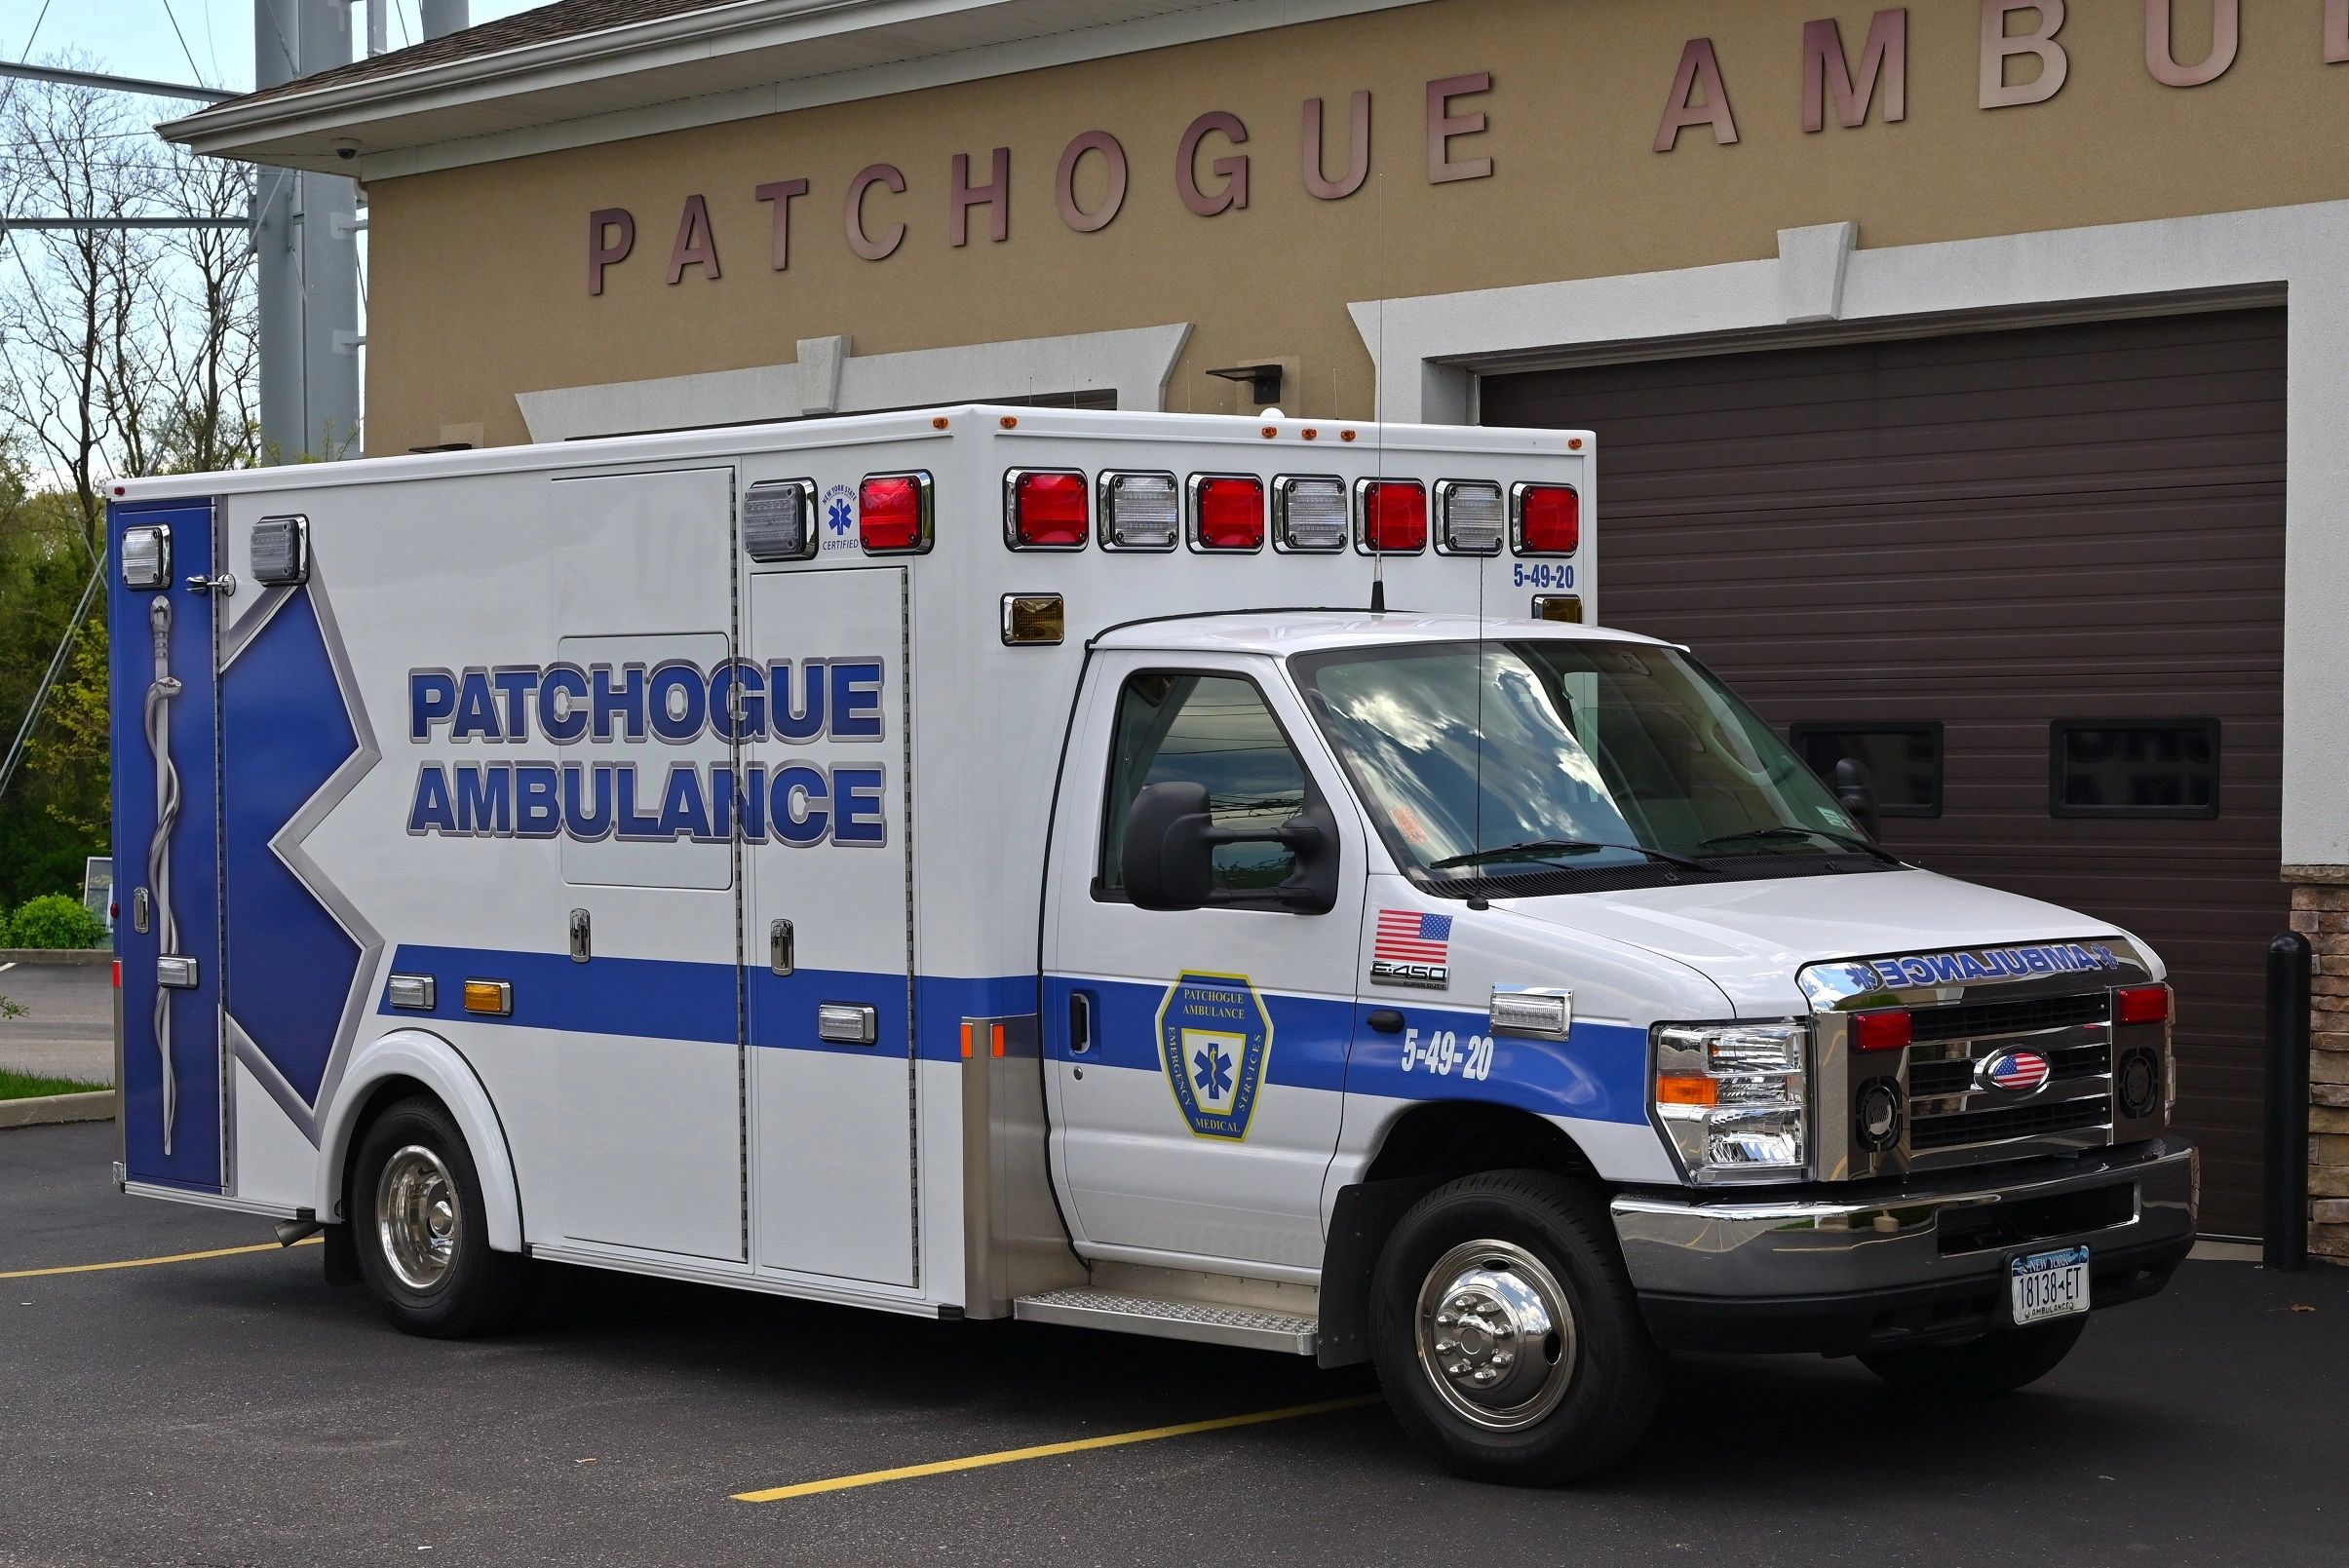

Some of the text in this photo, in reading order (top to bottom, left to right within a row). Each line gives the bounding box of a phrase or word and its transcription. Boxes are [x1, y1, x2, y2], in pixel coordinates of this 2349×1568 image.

[589, 0, 2349, 295] PATCHOGUE AMBU
[822, 484, 858, 505] NEW YORK STATE
[823, 539, 859, 551] CERTIFIED
[1514, 563, 1574, 589] 5-49-20
[408, 656, 885, 746] PATCHOGUE
[406, 759, 888, 849] AMBULANCE
[1183, 988, 1245, 1005] PATCHOGUE
[1182, 1005, 1246, 1019] AMBULANCE
[1401, 1028, 1494, 1082] 5-49-20
[1168, 1026, 1262, 1133] EMERGENCY MEDICAL SERVICES
[2029, 1253, 2069, 1273] NEW YORK
[2031, 1301, 2069, 1316] AMBULANCE
